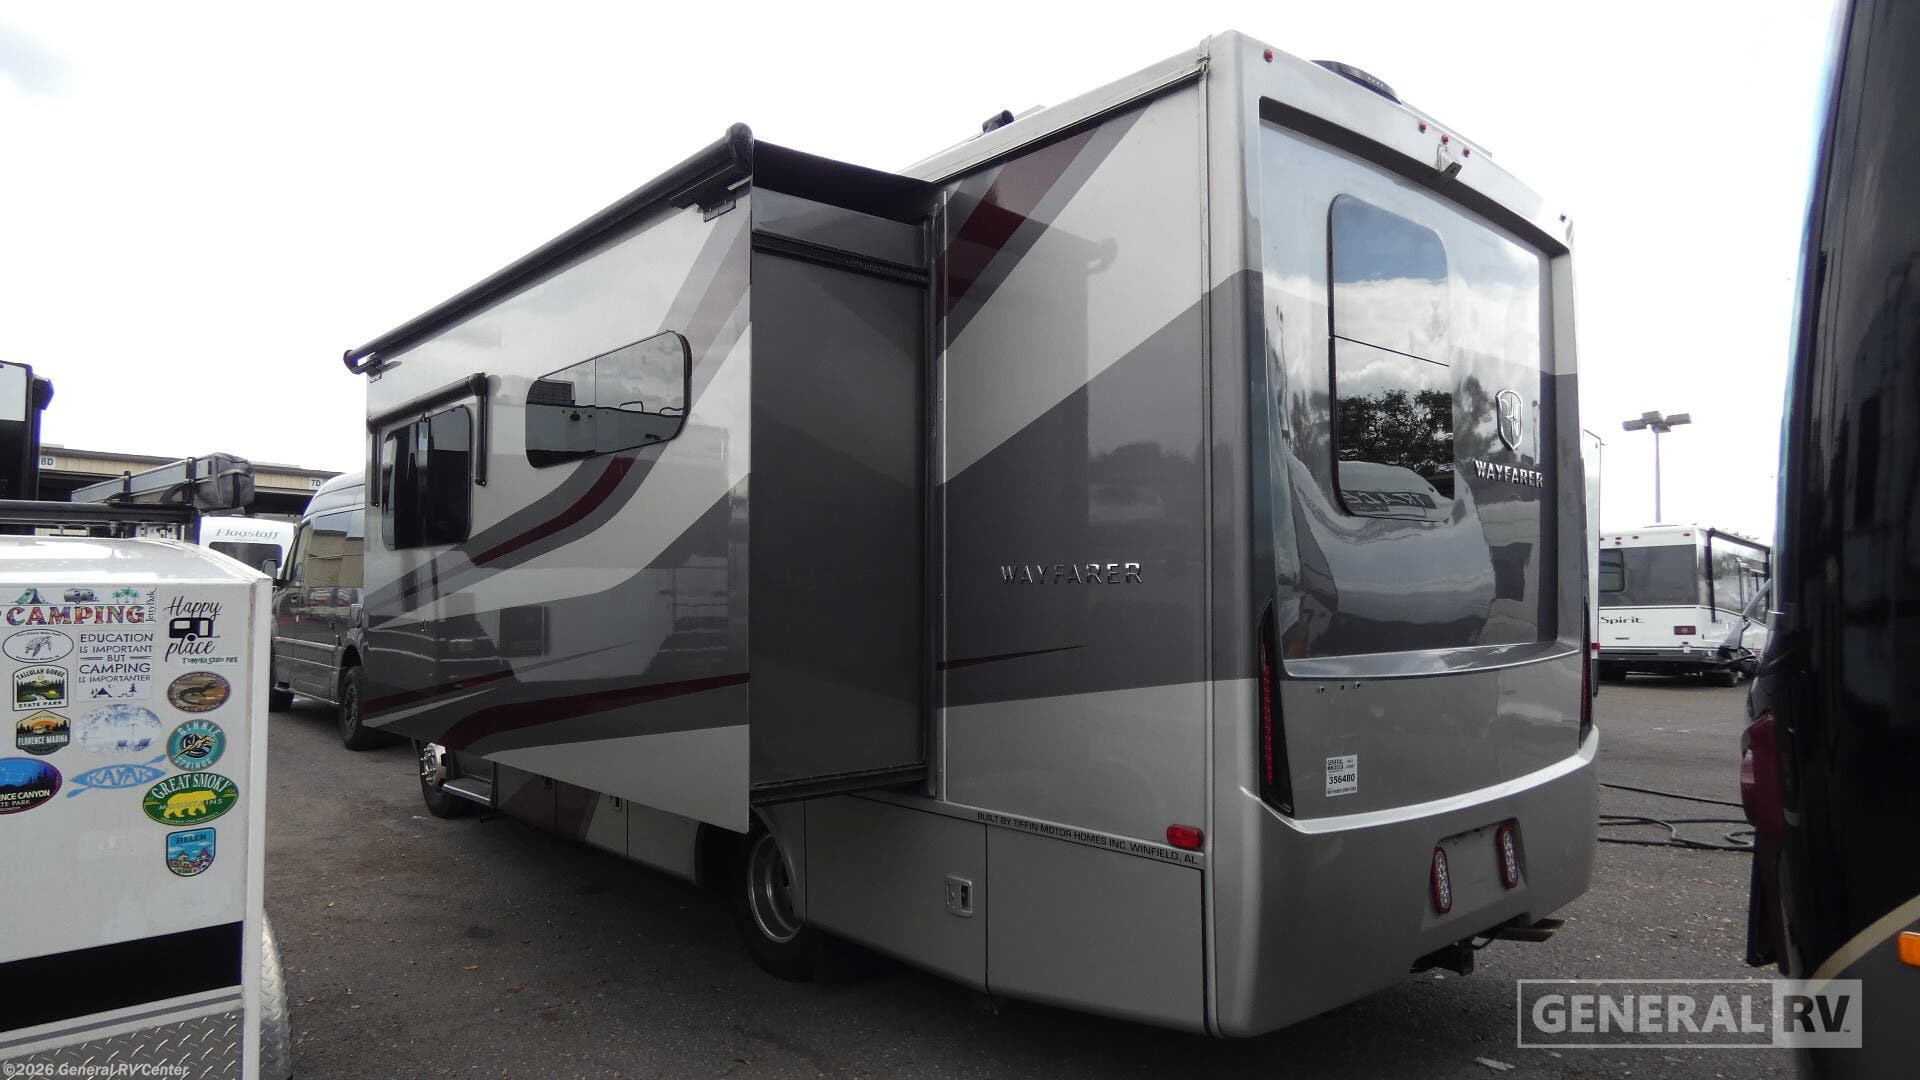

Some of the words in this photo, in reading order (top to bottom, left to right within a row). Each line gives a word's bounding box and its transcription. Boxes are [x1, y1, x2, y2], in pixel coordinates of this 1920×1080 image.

[41, 457, 54, 466] 8D
[1475, 459, 1544, 488] WAYFARER
[311, 479, 321, 487] 7D
[216, 528, 280, 539] Flagstaff
[1000, 562, 1144, 584] WAYFARER
[163, 595, 222, 621] Happy
[6, 605, 145, 626] CAMPING
[1600, 616, 1645, 624] Spirit
[80, 633, 154, 643] EDUCATION
[92, 645, 152, 653] IMPORTANT
[165, 636, 215, 662] place
[107, 654, 125, 662] BUT
[79, 662, 151, 675] CAMPING
[89, 674, 151, 682] IMPORTANTER
[18, 736, 46, 746] FLORENCE
[87, 767, 154, 786] KAYAK
[1329, 773, 1355, 785] 356480
[151, 774, 192, 799] GREAT
[193, 773, 232, 792] SMOKY
[17, 790, 51, 799] CANYON
[176, 833, 207, 844] HELEN
[1013, 820, 1039, 832] TIFFIN
[1040, 825, 1072, 838] MOTOR
[1074, 831, 1107, 846] HOMES
